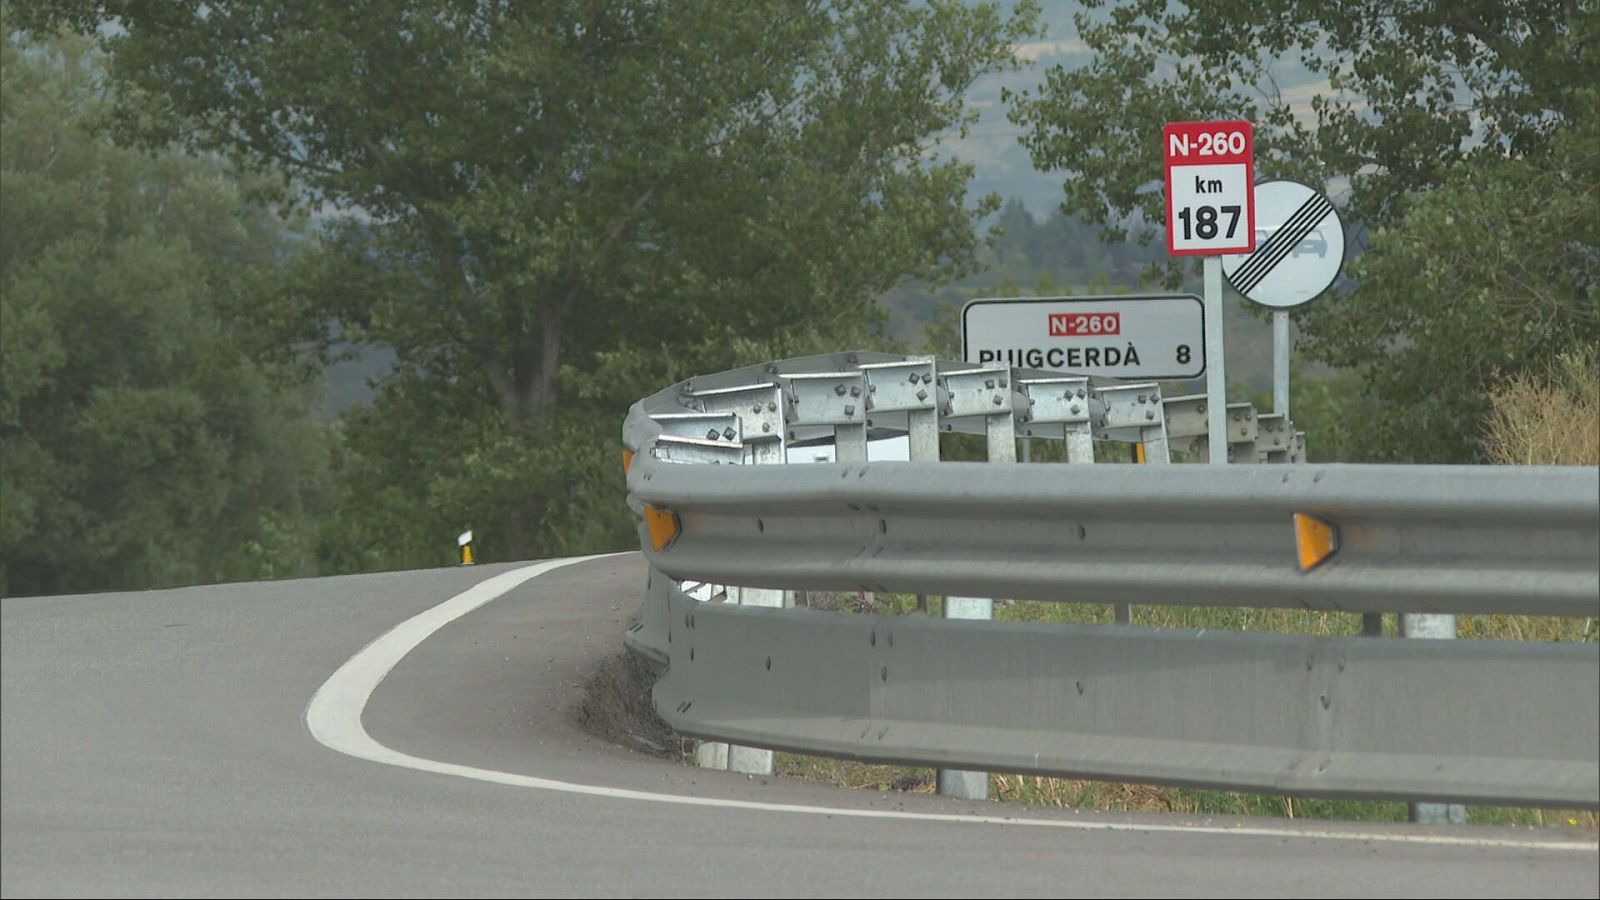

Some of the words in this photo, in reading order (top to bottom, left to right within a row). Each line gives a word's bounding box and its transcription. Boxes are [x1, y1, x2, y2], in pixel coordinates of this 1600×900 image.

[1169, 131, 1246, 157] N-260
[1195, 175, 1223, 194] km
[1178, 205, 1241, 240] 187
[1051, 316, 1117, 333] N-260
[1176, 344, 1191, 364] 8
